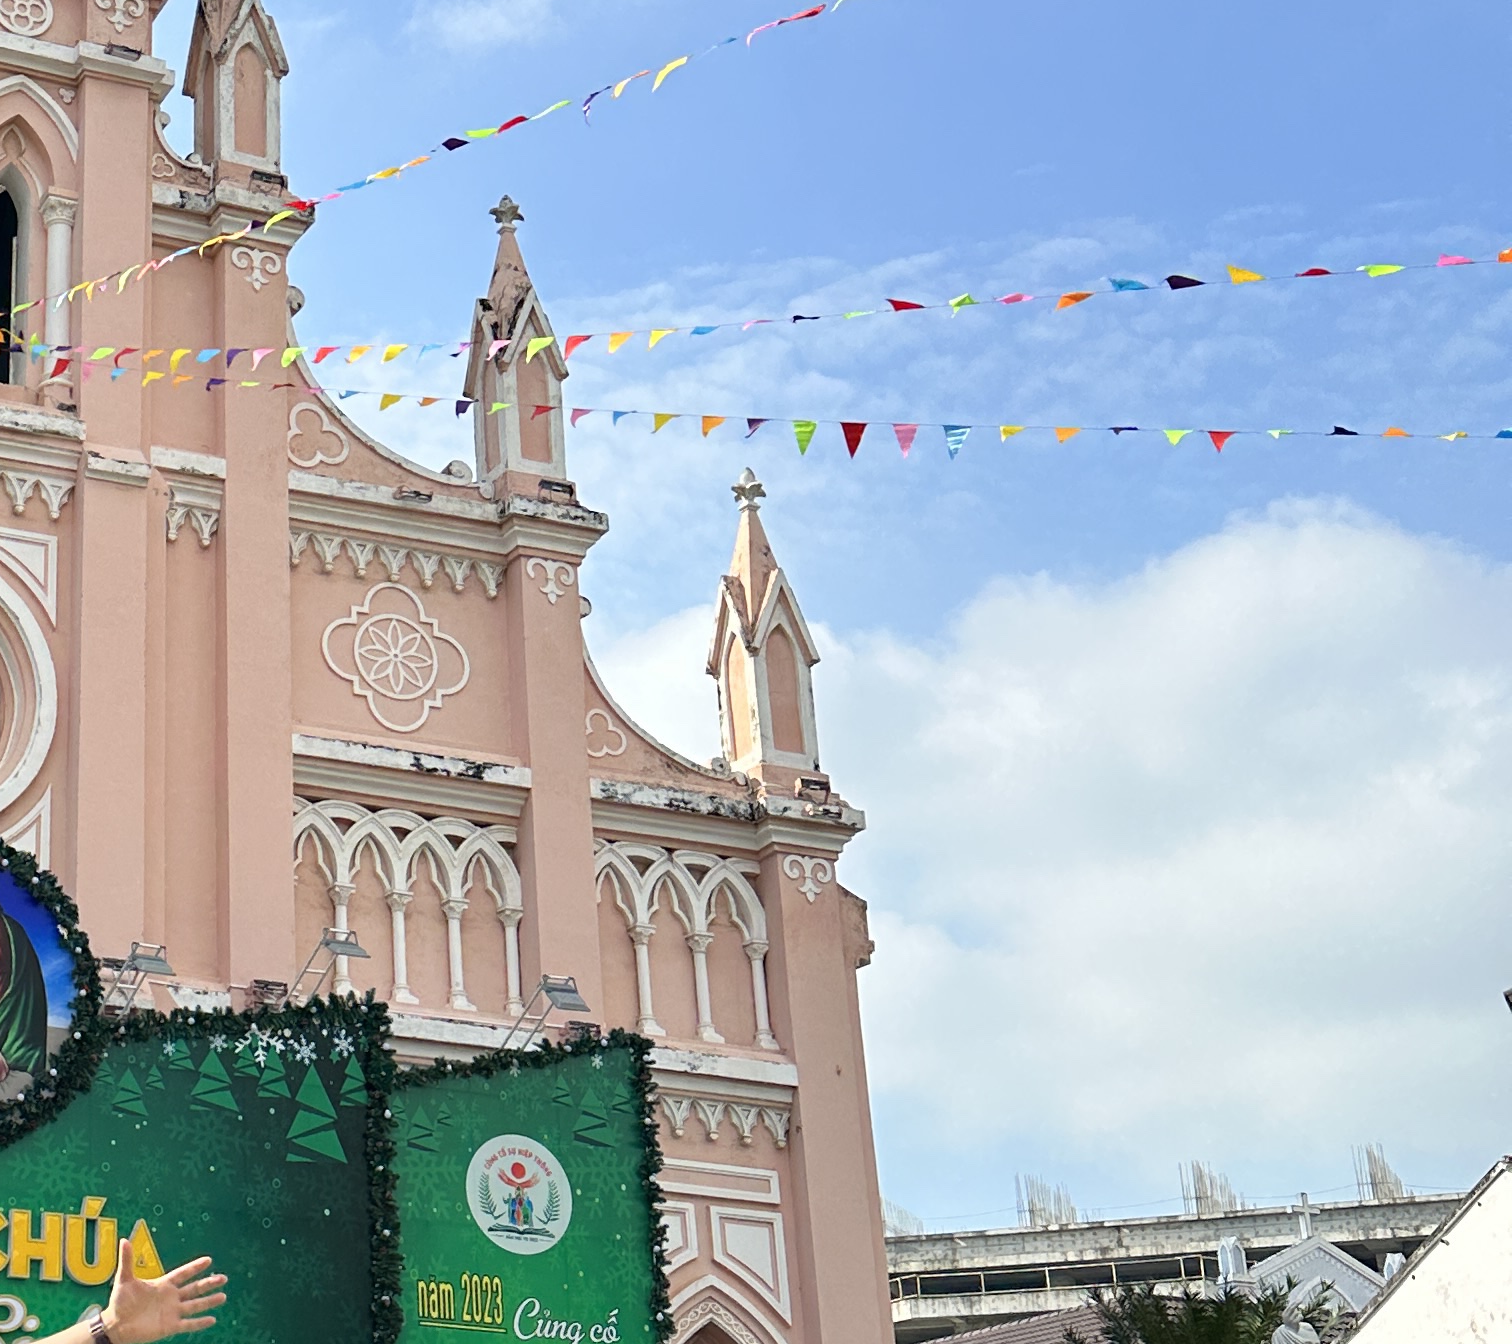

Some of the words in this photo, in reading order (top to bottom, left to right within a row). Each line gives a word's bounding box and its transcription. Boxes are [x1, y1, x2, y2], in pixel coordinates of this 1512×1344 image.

[417, 1274, 455, 1321] năm
[461, 1272, 504, 1325] 2023
[589, 1308, 621, 1344] cố
